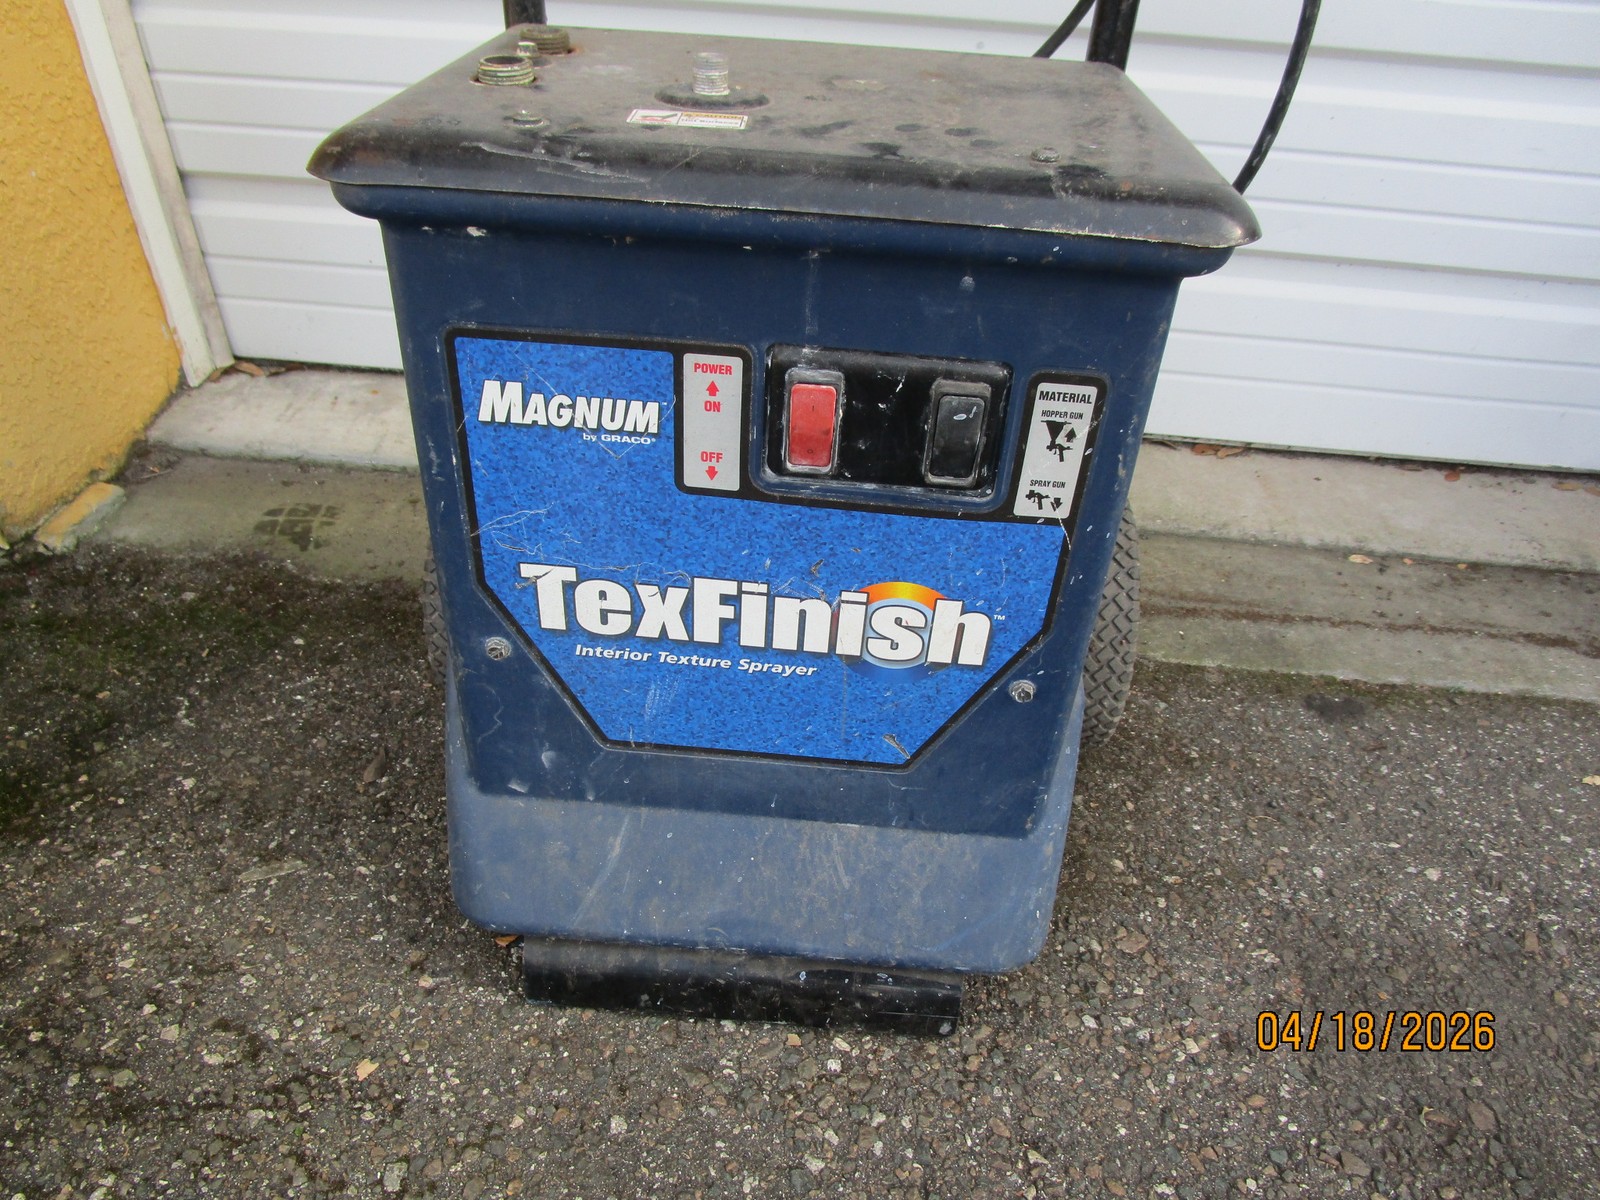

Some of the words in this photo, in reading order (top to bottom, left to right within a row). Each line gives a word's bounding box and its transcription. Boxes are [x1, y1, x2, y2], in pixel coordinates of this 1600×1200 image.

[694, 363, 733, 375] POWER
[1038, 390, 1093, 405] MATERIAL
[704, 400, 721, 413] ON
[1041, 410, 1068, 419] HOPPER
[1069, 412, 1084, 420] GUN
[582, 432, 597, 442] by
[700, 451, 723, 463] OFF
[1030, 479, 1051, 488] SPRAY
[1052, 481, 1066, 489] GUN
[575, 644, 652, 662] Interior
[658, 651, 732, 669] Texture
[738, 658, 817, 677] Sprayer
